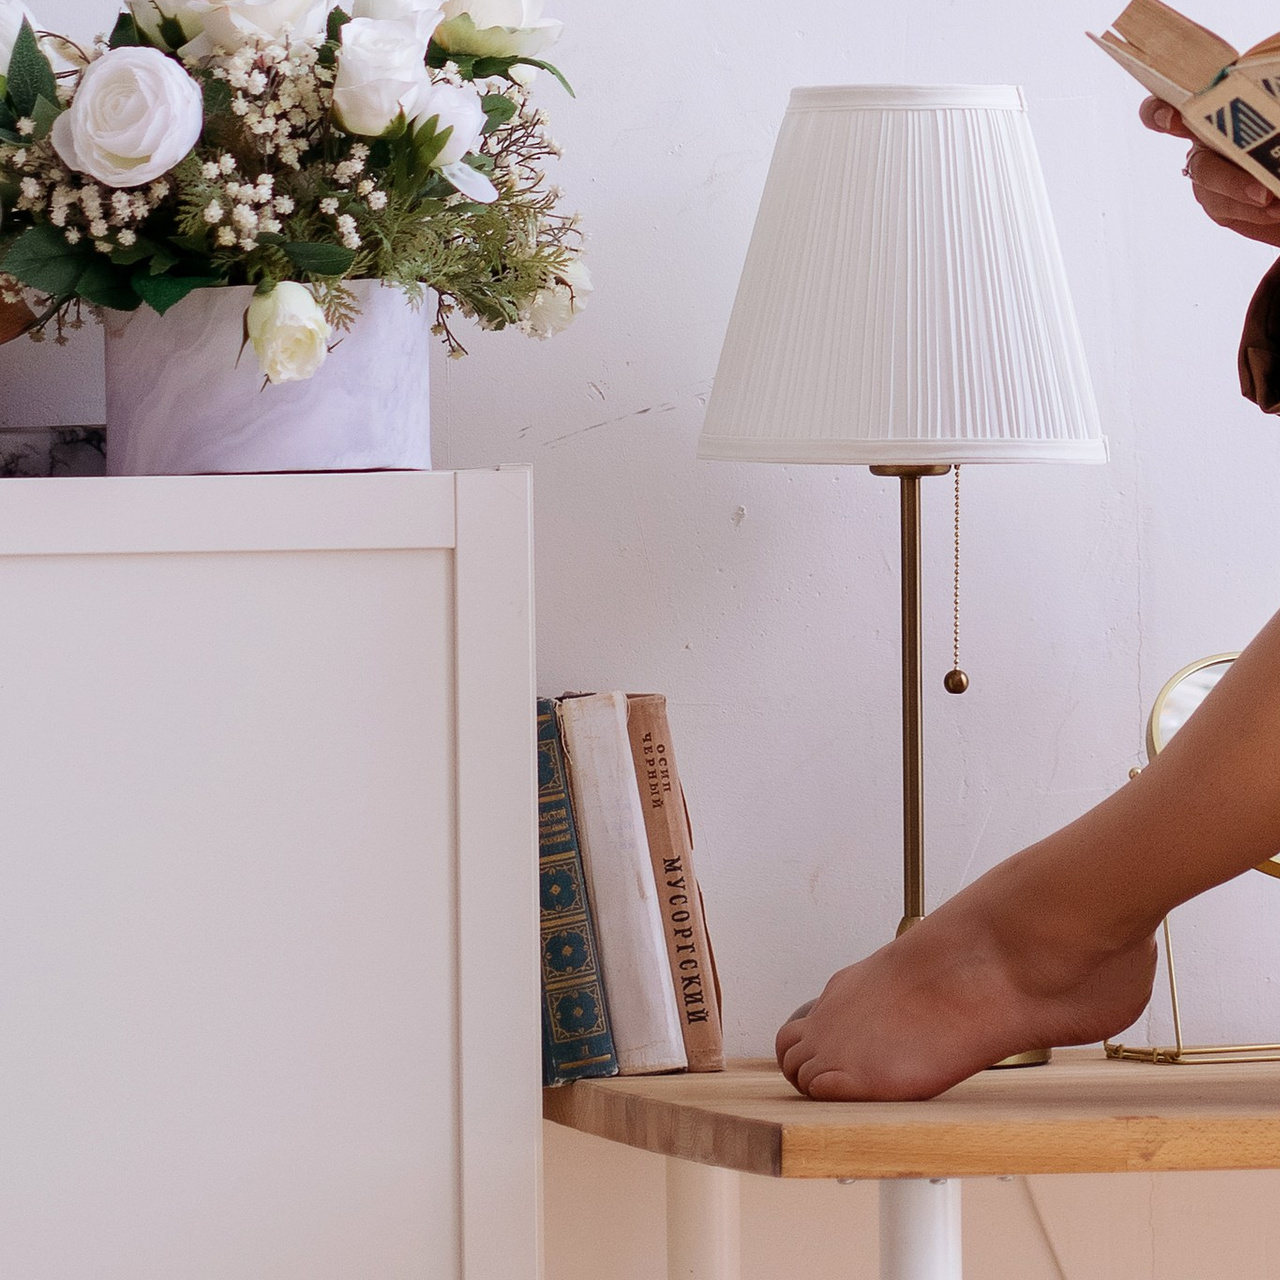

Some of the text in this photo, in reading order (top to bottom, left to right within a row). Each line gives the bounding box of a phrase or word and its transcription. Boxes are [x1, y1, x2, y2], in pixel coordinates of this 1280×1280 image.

[642, 732, 664, 809] ЧЕРНЫЙ
[656, 744, 671, 792] ОСИП
[663, 855, 709, 1025] МУСОРГСКИЙ
